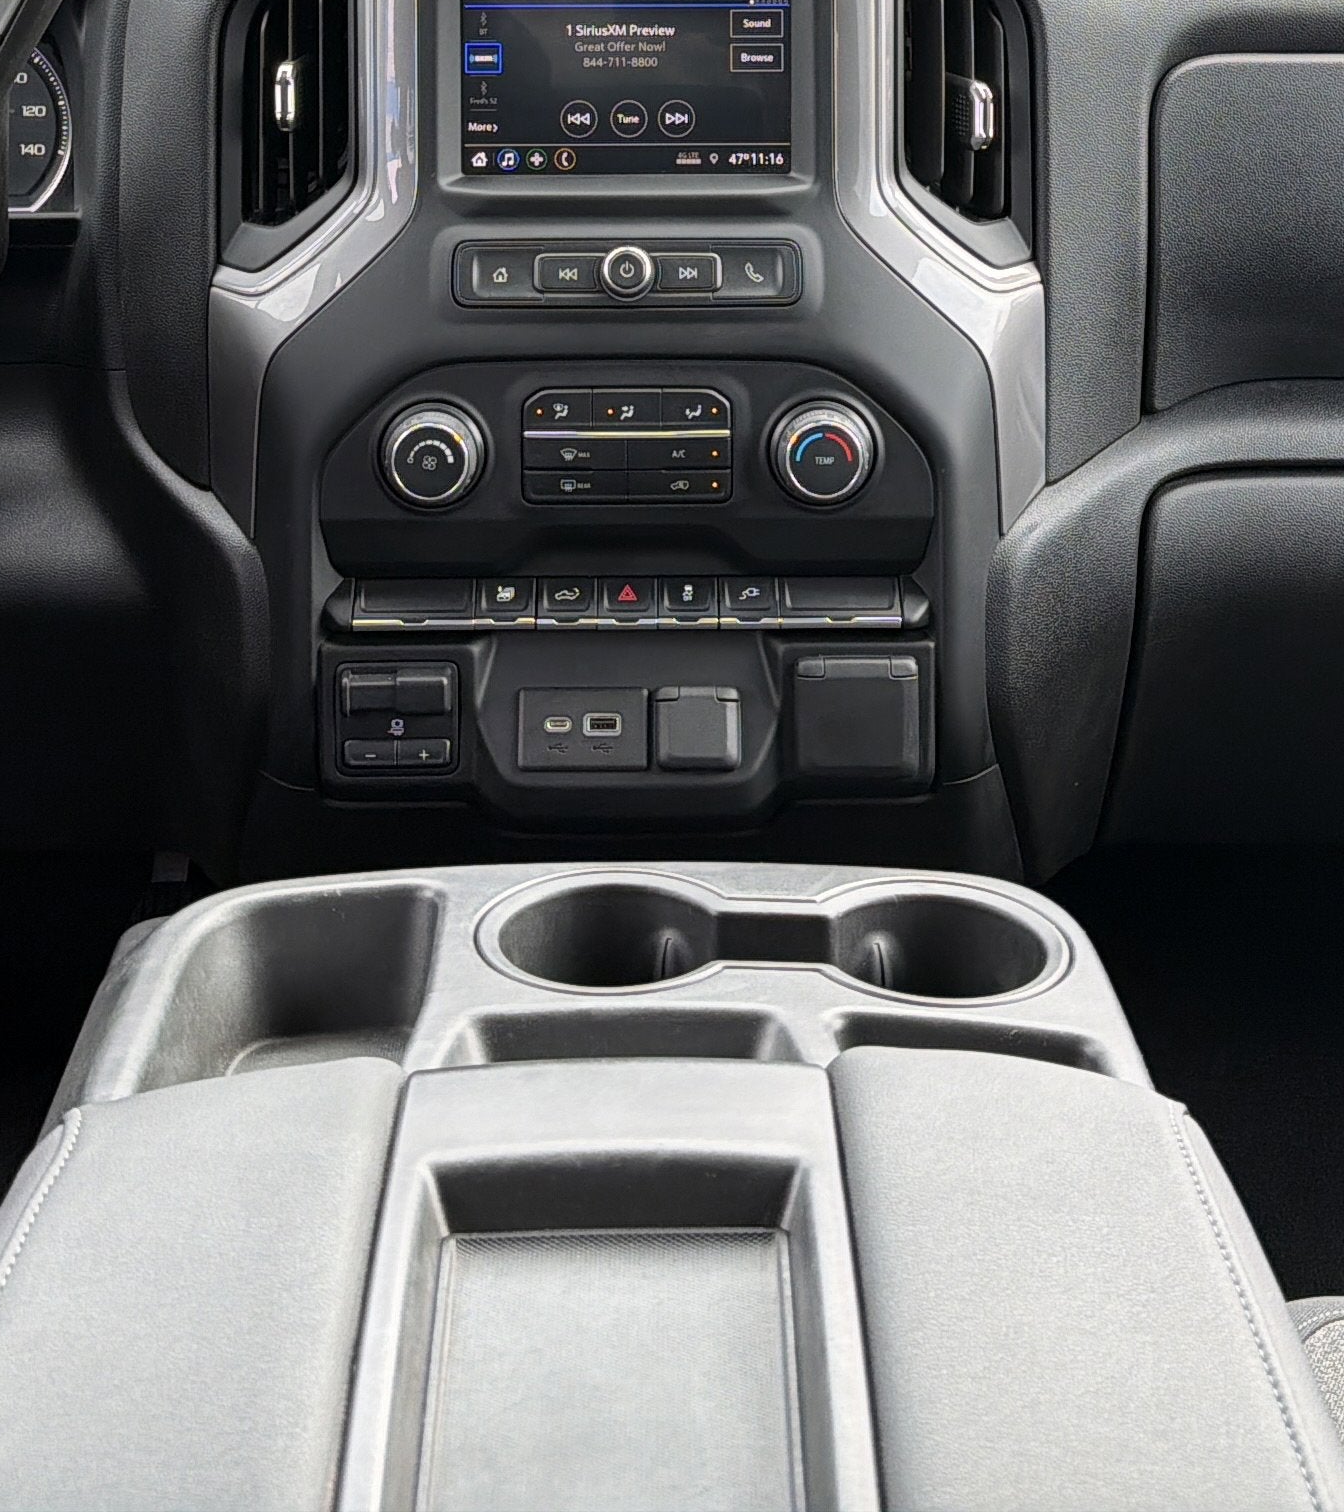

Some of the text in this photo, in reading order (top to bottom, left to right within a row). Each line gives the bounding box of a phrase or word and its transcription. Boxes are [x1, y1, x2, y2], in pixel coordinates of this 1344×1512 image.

[743, 19, 772, 29] Sound
[566, 24, 676, 37] 1 SiriusXM Preview
[574, 41, 666, 52] Great Offer Now!
[582, 57, 658, 68] 844-711-8800
[741, 52, 774, 62] Browse
[21, 105, 47, 117] 120
[617, 113, 640, 124] Tune
[19, 143, 46, 156] 140
[750, 152, 784, 165] 11:16
[670, 450, 685, 459] A/C
[814, 456, 835, 465] TEMP
